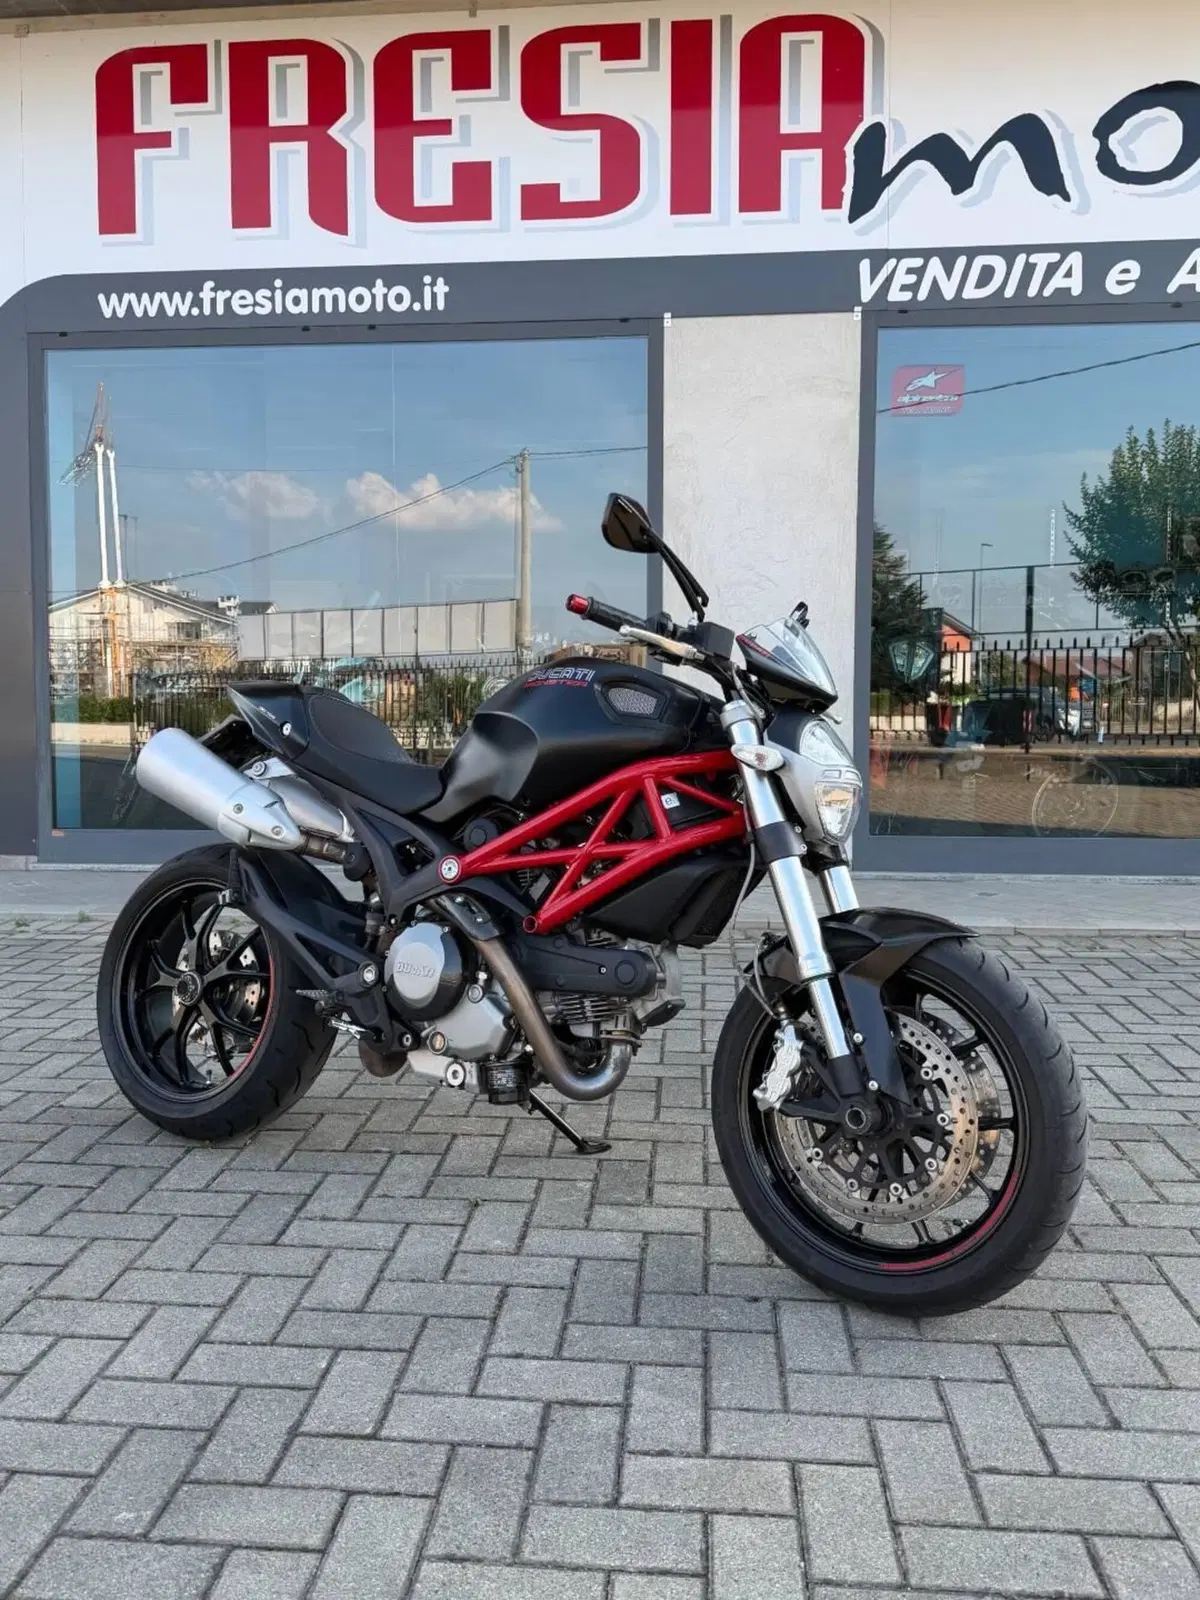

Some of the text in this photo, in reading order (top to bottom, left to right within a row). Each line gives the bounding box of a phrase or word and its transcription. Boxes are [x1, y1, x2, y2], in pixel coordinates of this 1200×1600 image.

[95, 13, 866, 236] FRESIA
[97, 276, 449, 319] www.fresiamoto.it
[859, 251, 1083, 303] VENDITA
[1105, 260, 1141, 295] e
